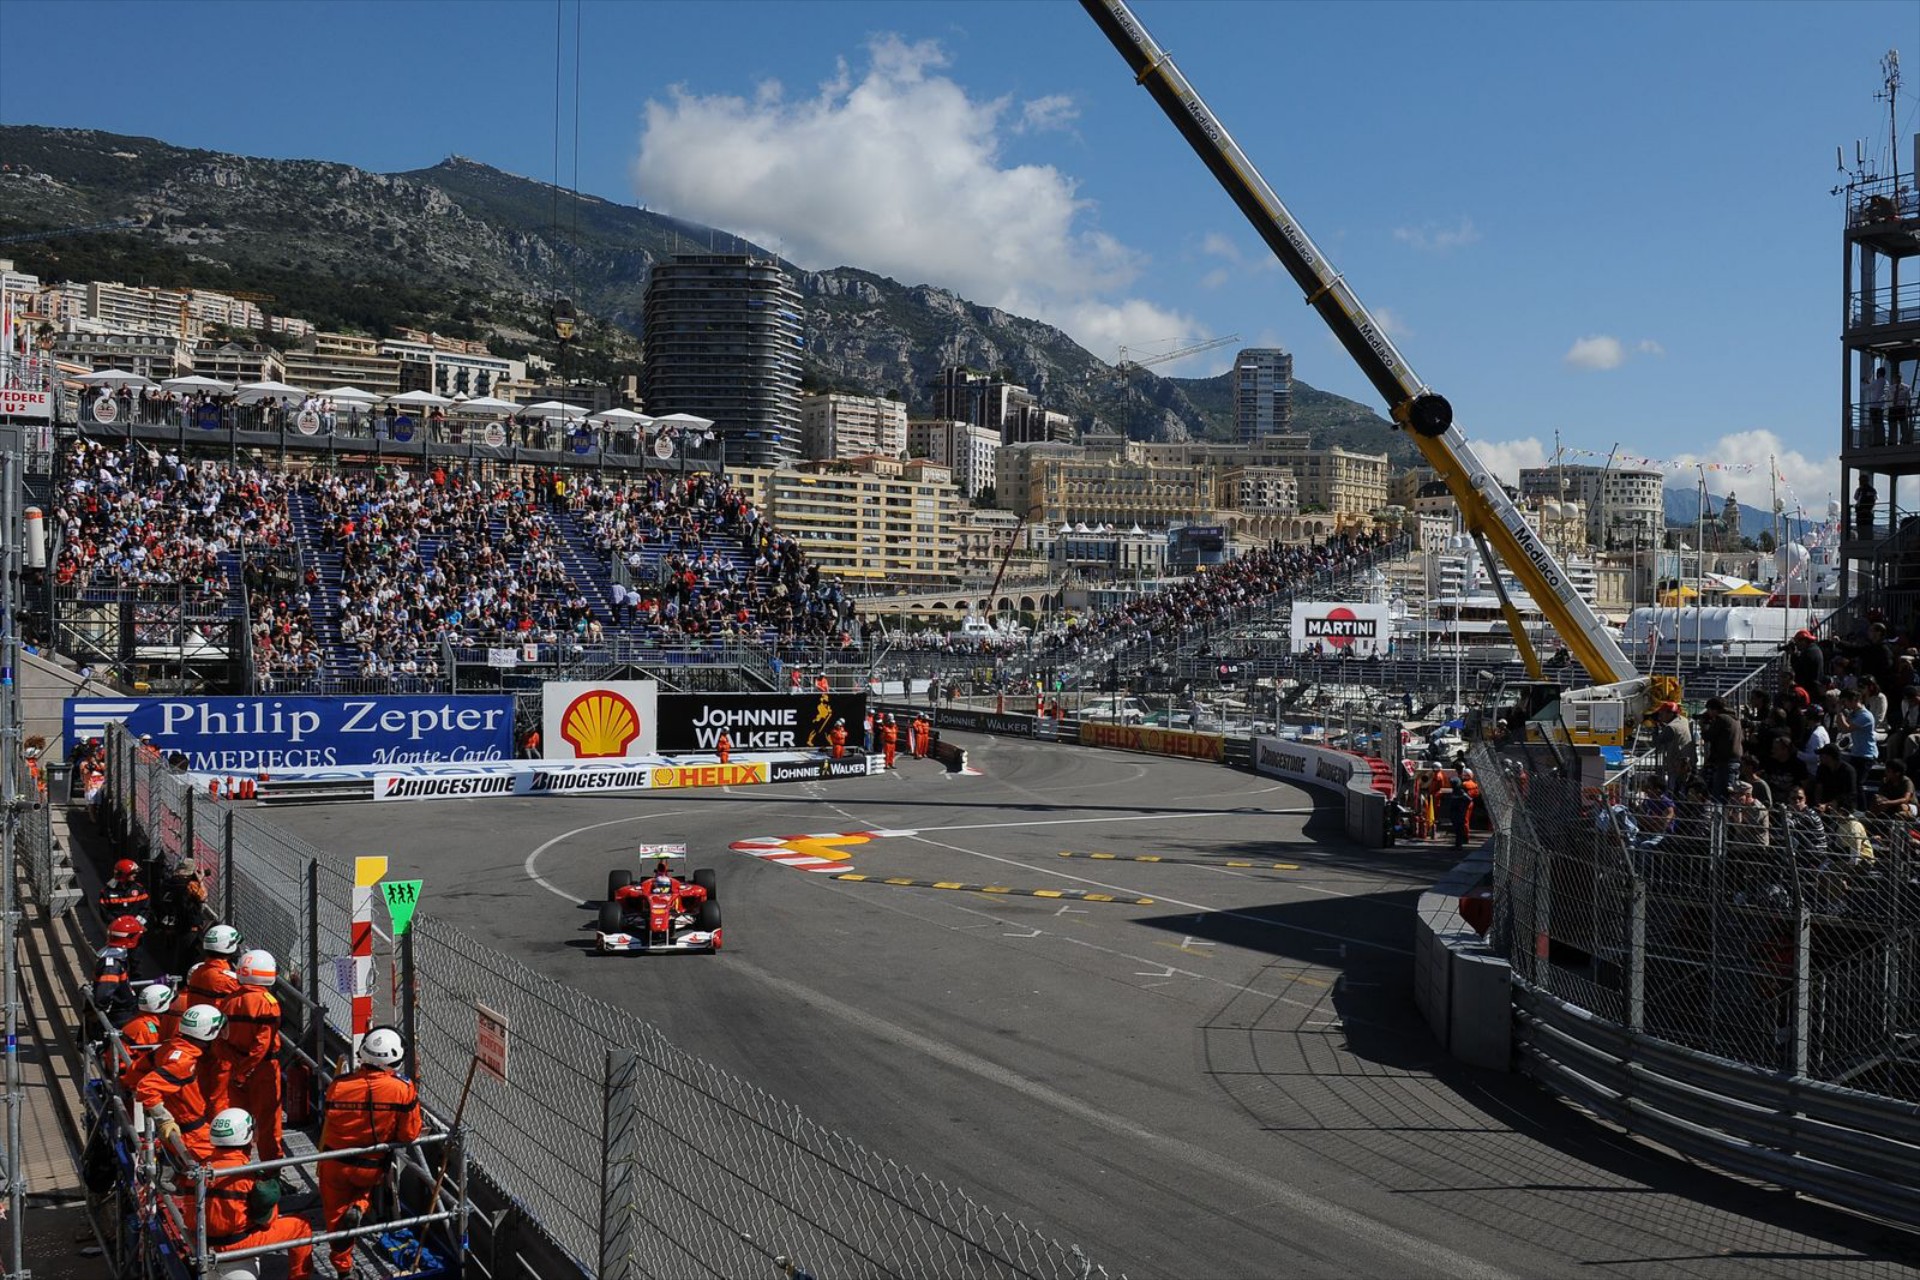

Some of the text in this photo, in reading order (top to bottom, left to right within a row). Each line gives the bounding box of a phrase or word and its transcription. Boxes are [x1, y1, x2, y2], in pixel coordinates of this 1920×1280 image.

[1113, 7, 1141, 43] Mediaco
[1187, 101, 1219, 141] Mediaco
[1282, 224, 1314, 264] Mediaco
[1360, 323, 1394, 368] Mediaco
[1514, 526, 1561, 588] Mediaco
[1308, 621, 1374, 636] MARTINI
[1228, 665, 1238, 673] LG
[158, 701, 504, 743] Philip Zepter
[692, 705, 798, 728] JOHNNIE
[937, 713, 1028, 733] JOHNNIE WALKER
[372, 744, 502, 765] Monte-Carlo
[1095, 726, 1220, 761] HELIX HELIX
[159, 747, 337, 772] TIMEPIECES
[773, 762, 866, 780] JOHNNIE WALKER
[1260, 745, 1307, 774] BRIDGESTONE
[385, 775, 516, 797] BRIDGESTONE
[530, 770, 647, 791] BRIDGESTONE
[680, 765, 760, 788] HELIX
